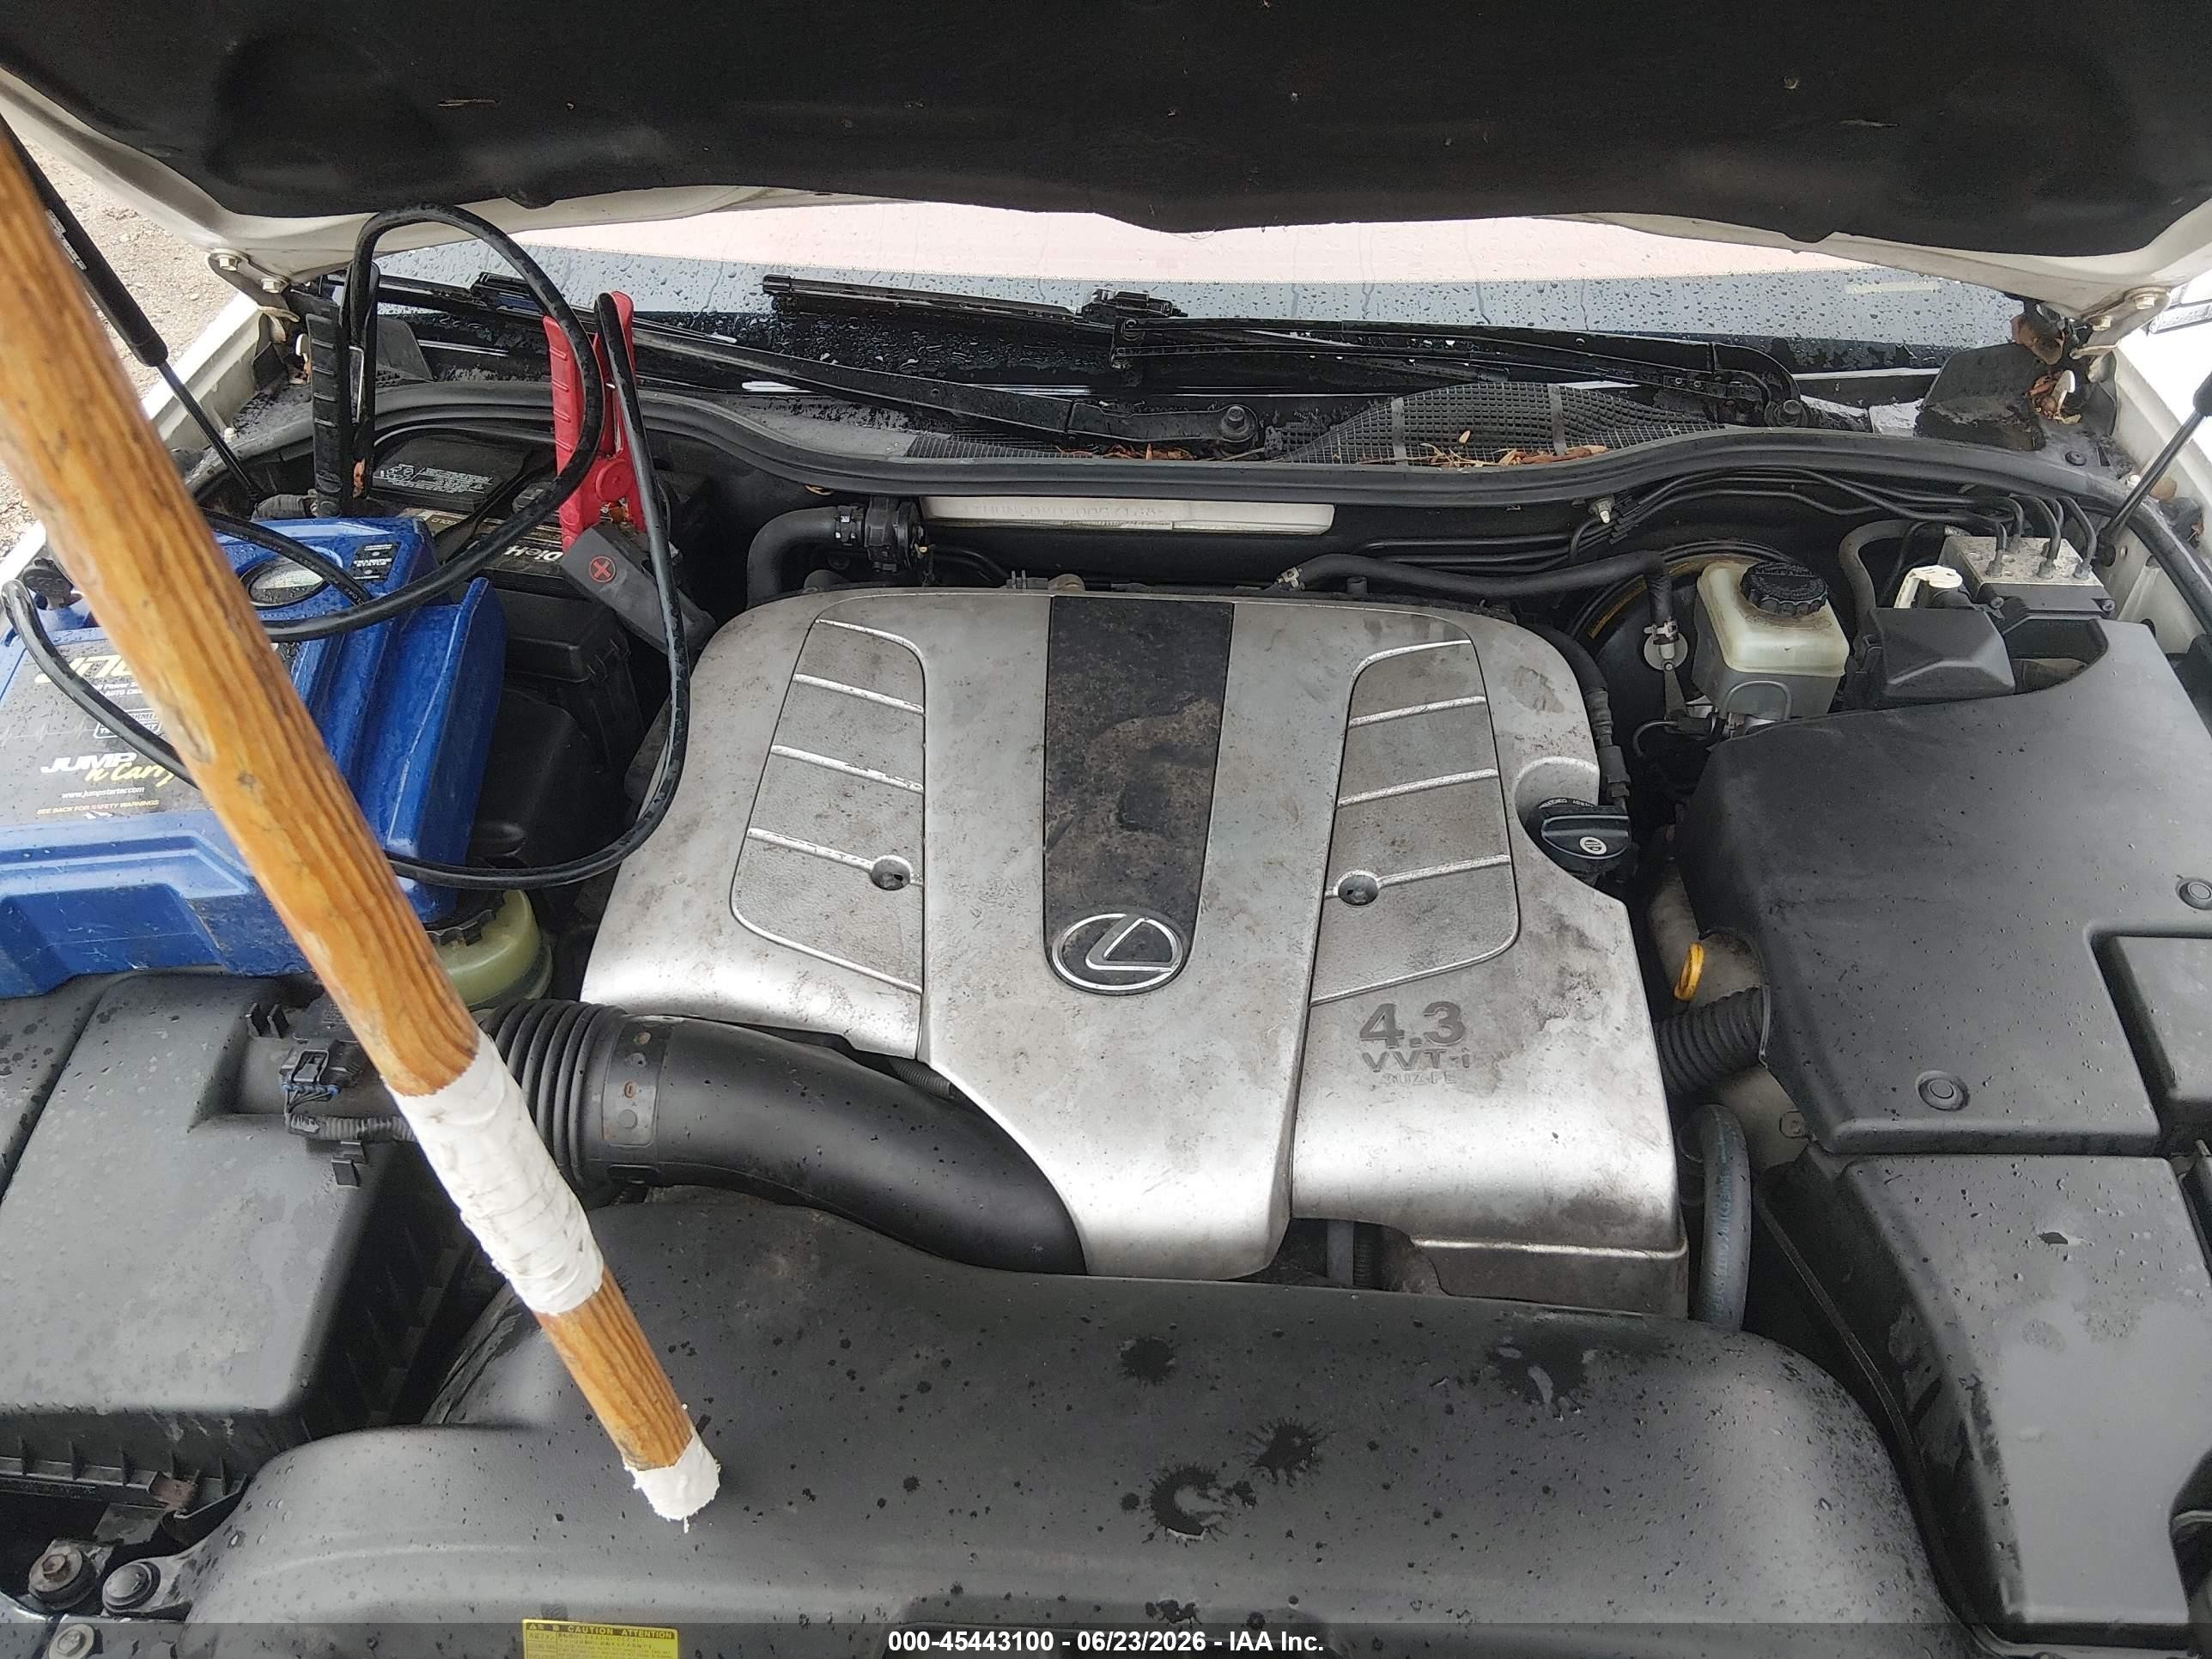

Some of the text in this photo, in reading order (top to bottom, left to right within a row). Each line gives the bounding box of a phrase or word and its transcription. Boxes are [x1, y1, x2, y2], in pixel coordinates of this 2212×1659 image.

[431, 517, 458, 526] GOLD
[503, 545, 563, 562] DieH
[40, 752, 137, 774] JUMP
[61, 787, 145, 799] www.jumpstarter.com
[90, 802, 119, 811] SAFETY
[119, 799, 160, 808] WARNINGS
[1358, 1000, 1467, 1048] 4.3
[1362, 1047, 1471, 1073] VVT-i
[567, 1626, 613, 1635] CAUTION
[621, 1628, 672, 1638] ATTENTION
